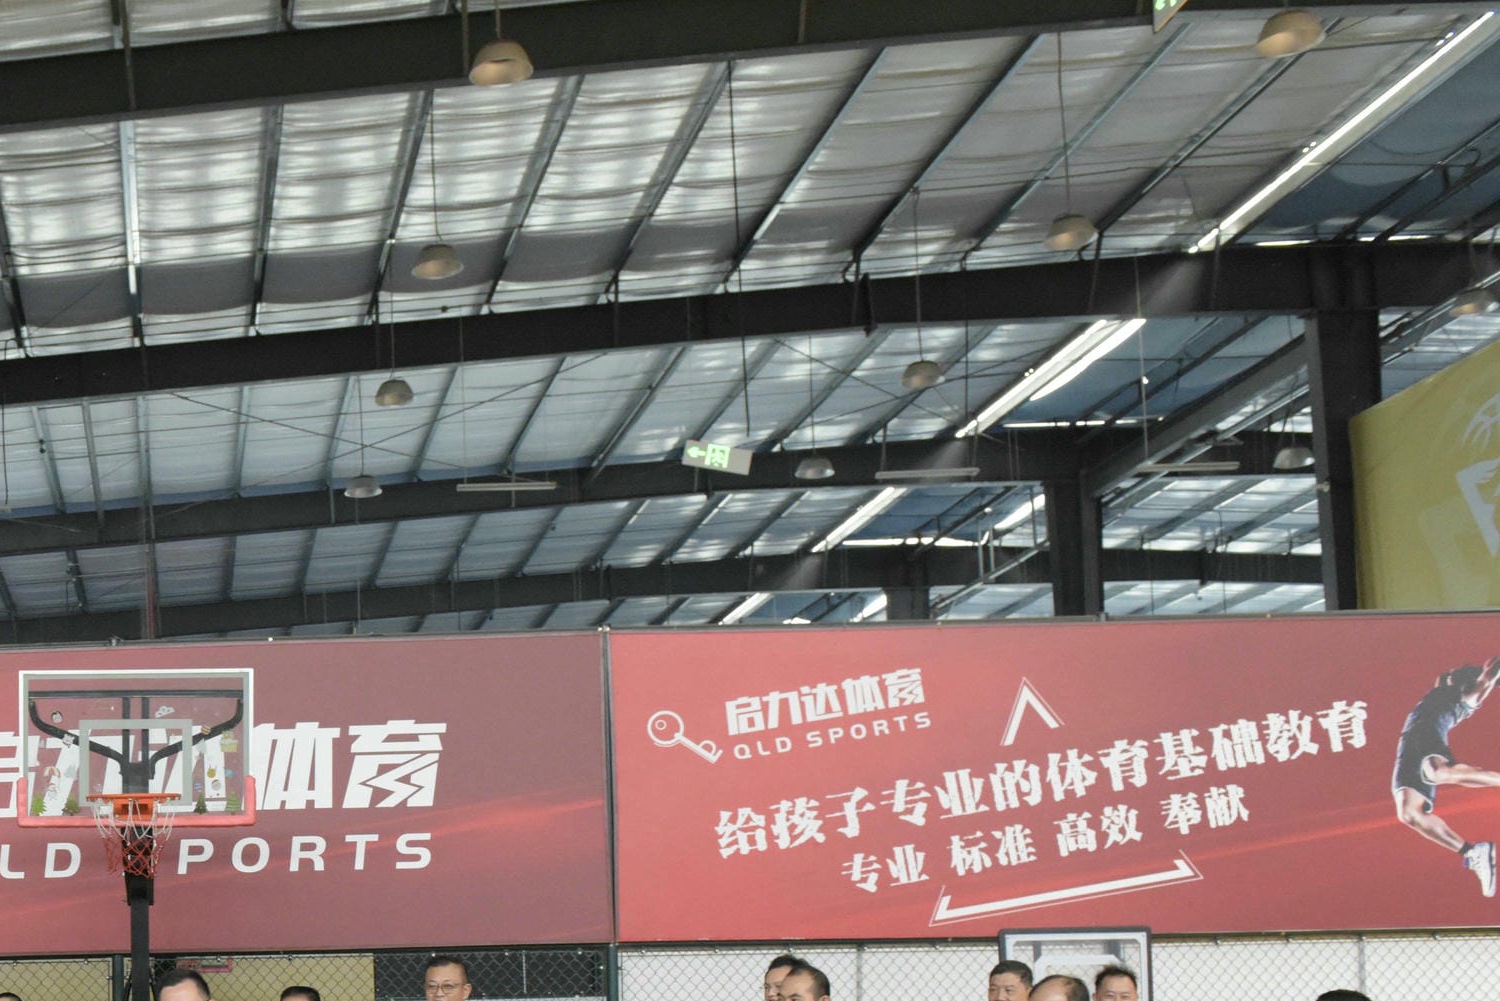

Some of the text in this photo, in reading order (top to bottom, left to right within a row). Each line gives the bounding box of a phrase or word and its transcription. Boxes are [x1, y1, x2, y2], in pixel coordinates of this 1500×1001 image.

[724, 668, 926, 736] 启力达体育
[733, 711, 932, 760] QLD SPORTS
[713, 700, 1368, 858] 给孩子专业的体育基础教育
[168, 832, 432, 875] PORTS
[841, 784, 1250, 893] 专业 标准 高效 奉献
